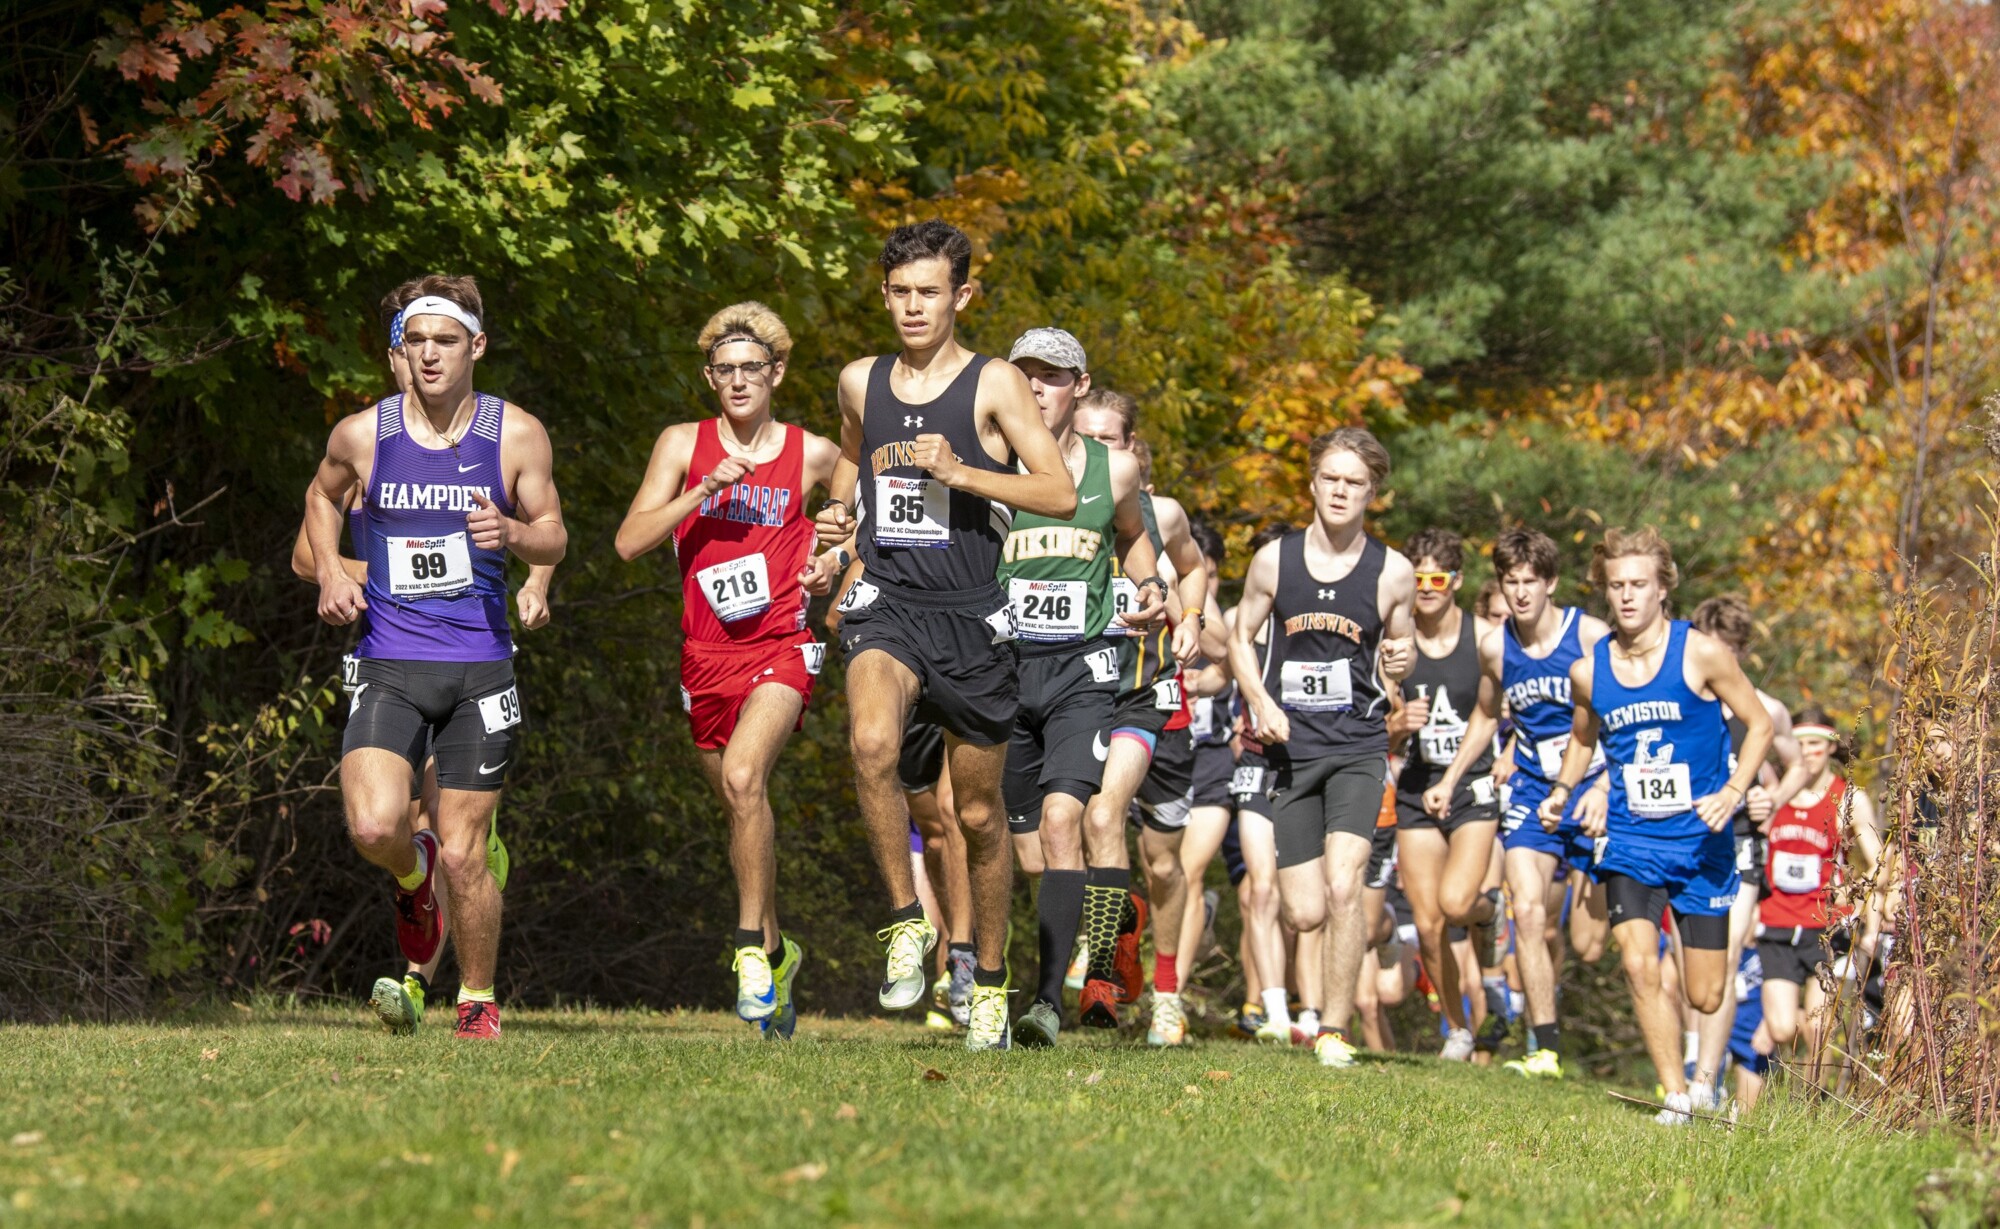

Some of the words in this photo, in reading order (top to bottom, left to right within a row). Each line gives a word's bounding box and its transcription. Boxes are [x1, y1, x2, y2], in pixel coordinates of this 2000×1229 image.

[379, 482, 491, 512] HAMPDEN
[888, 479, 928, 491] MileSplit
[726, 484, 790, 527] ARABAT
[889, 494, 924, 524] 35
[406, 539, 446, 550] MileSplit
[905, 528, 943, 536] Championships
[1003, 526, 1101, 563] VIKINGS
[411, 552, 448, 580] 99
[431, 577, 468, 589] Championships
[712, 570, 758, 604] 218
[1029, 582, 1067, 593] MileSplit
[1002, 604, 1019, 636] 35
[1022, 594, 1072, 621] 246
[1284, 612, 1363, 645] BRUNSWICK
[1302, 675, 1328, 696] 31
[499, 690, 520, 723] 99
[1604, 700, 1683, 732] LEWISTON
[1637, 778, 1677, 800] 134
